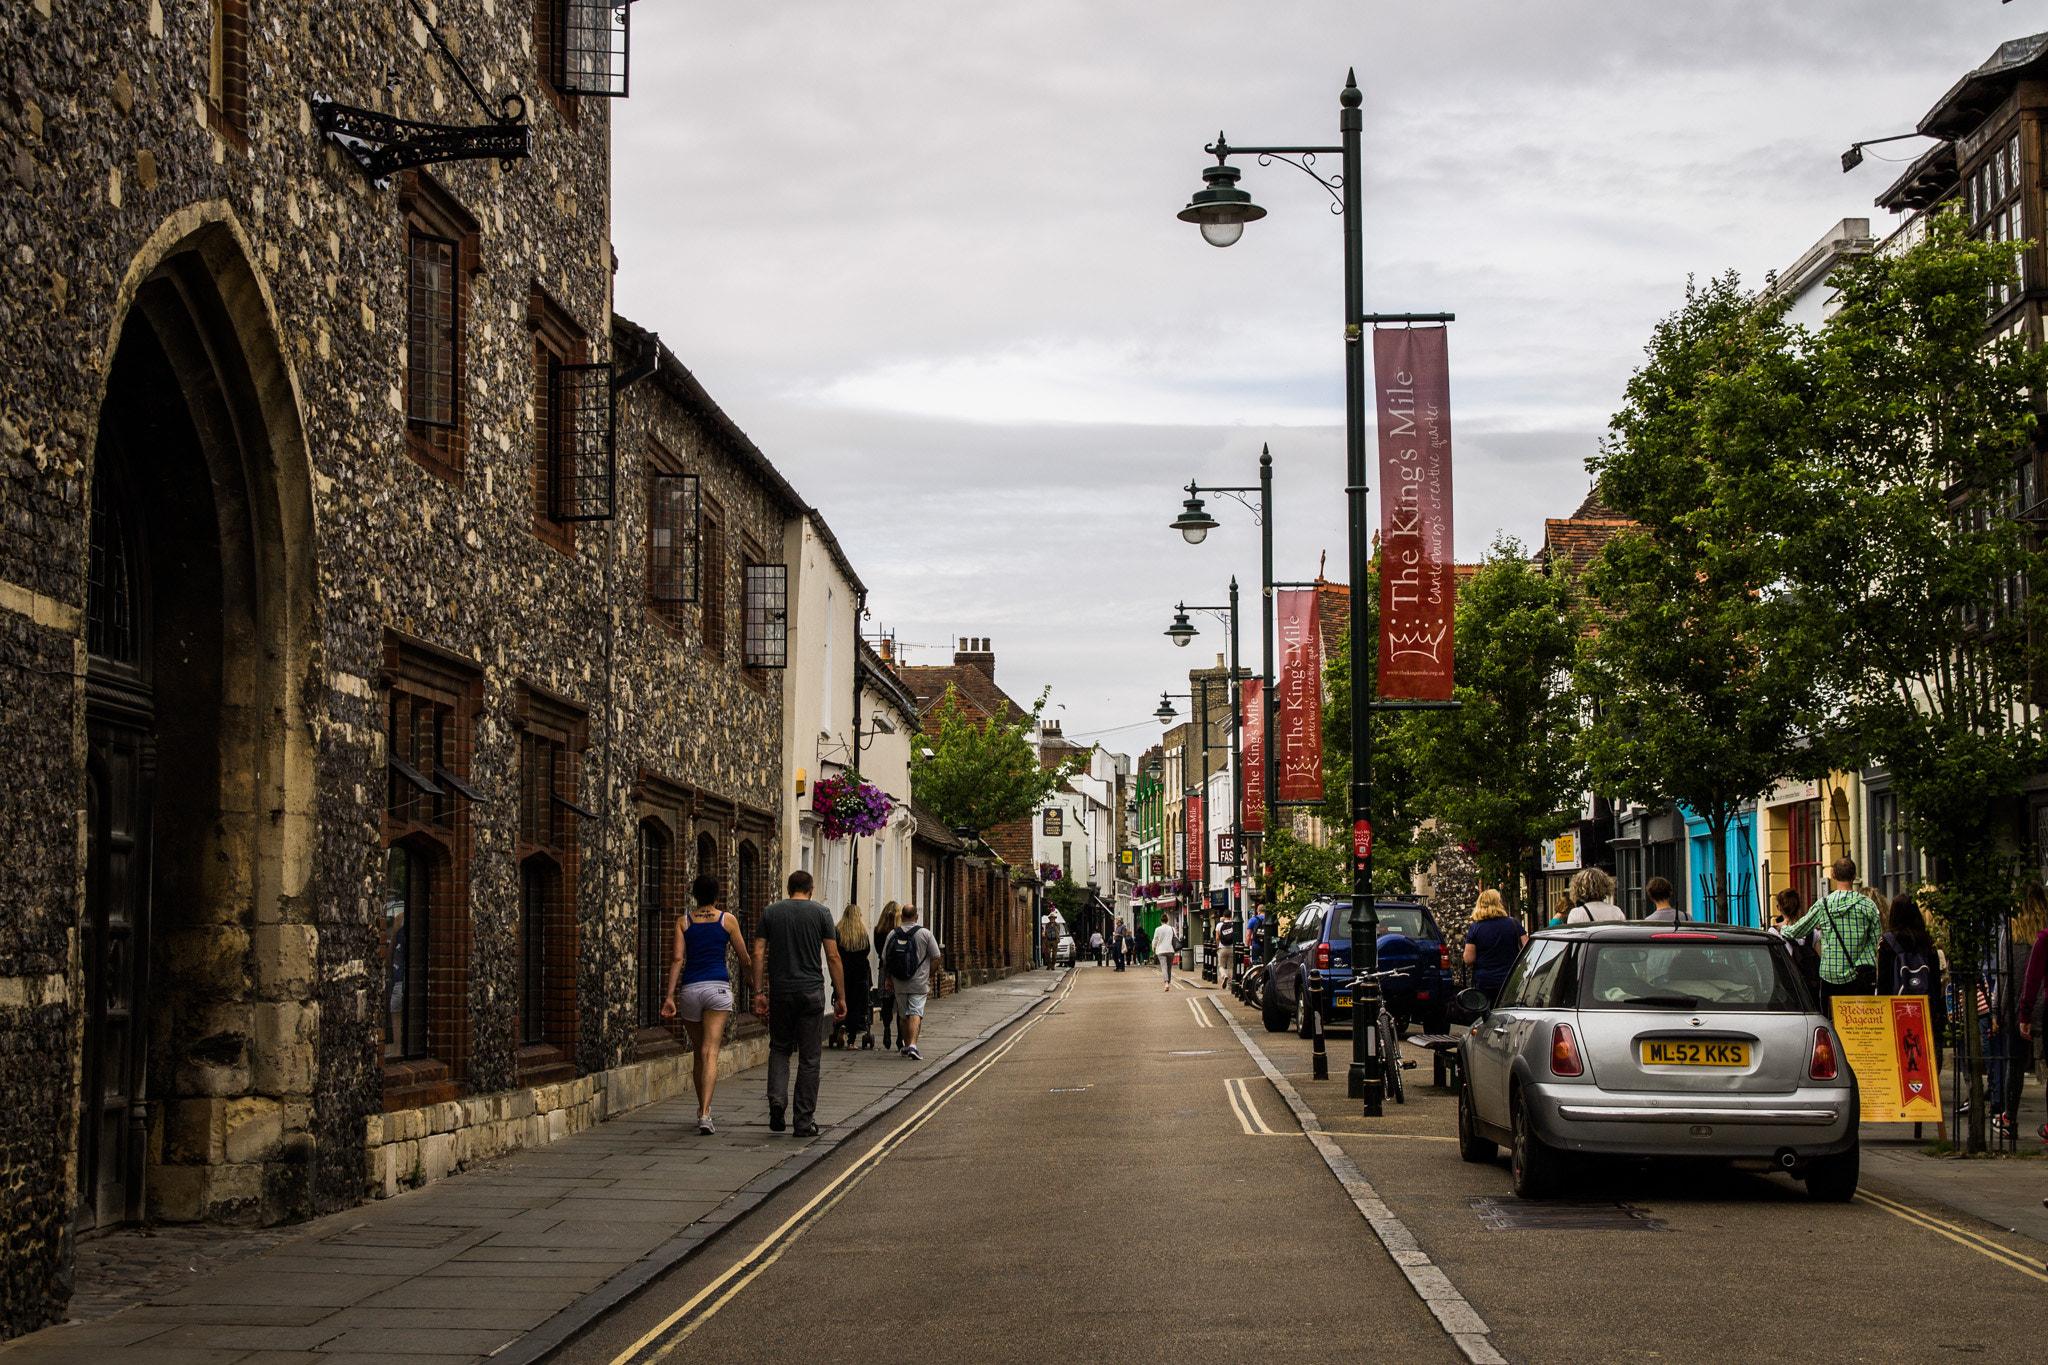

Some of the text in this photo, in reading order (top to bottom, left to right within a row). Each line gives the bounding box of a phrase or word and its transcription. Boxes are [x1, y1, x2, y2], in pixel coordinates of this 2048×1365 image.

[1424, 401, 1446, 448] quarter
[1386, 371, 1424, 612] The King's Mile
[1426, 453, 1441, 510] creative
[1284, 615, 1306, 752] The King's Mile
[1246, 697, 1262, 796] The King's Mile
[1189, 806, 1198, 861] The King's Mile
[1838, 1005, 1885, 1015] Medieval
[1844, 1014, 1883, 1026] Pageant
[1649, 1041, 1742, 1064] ML52 KKS
